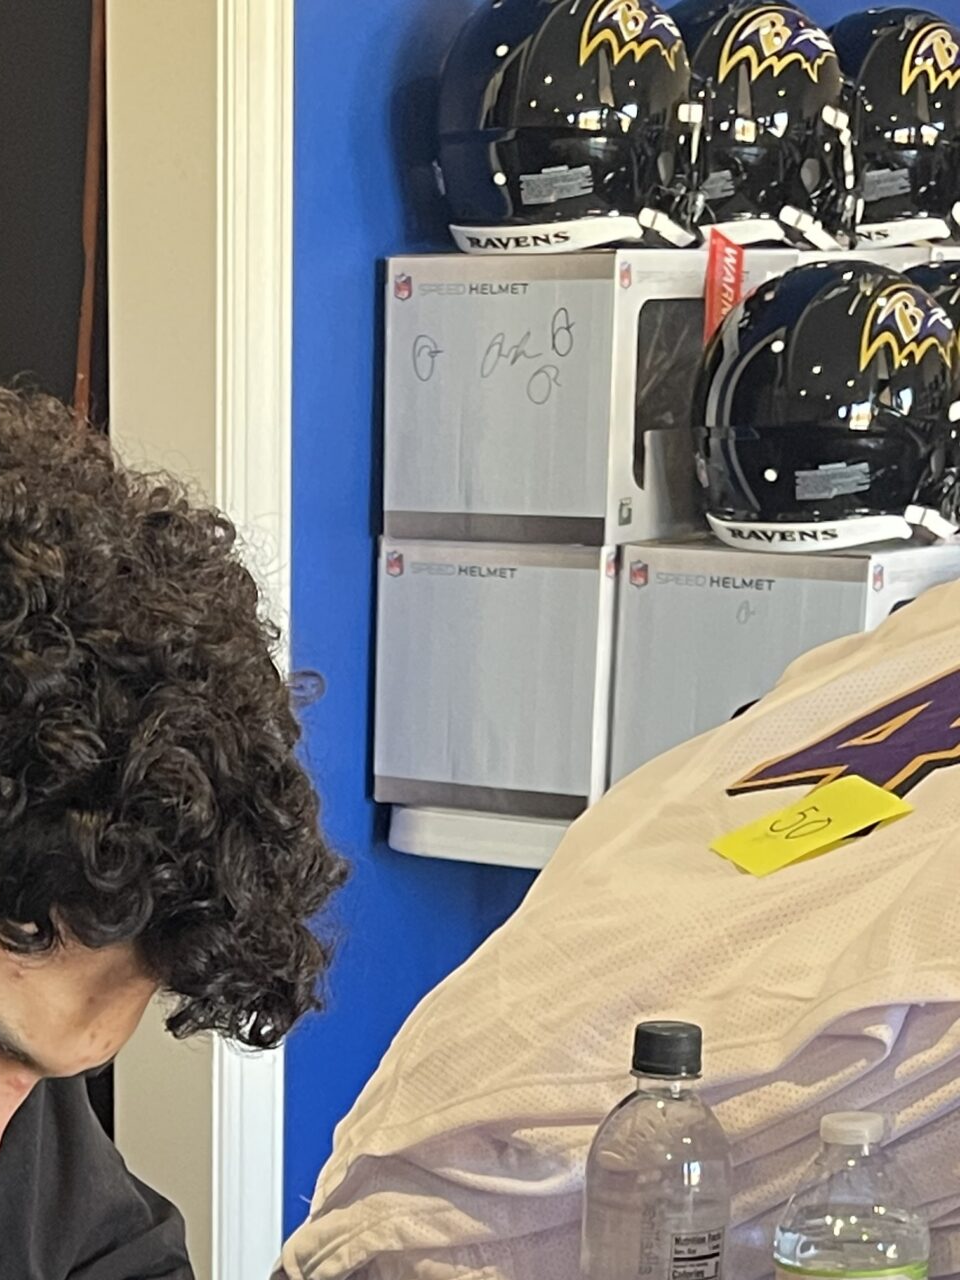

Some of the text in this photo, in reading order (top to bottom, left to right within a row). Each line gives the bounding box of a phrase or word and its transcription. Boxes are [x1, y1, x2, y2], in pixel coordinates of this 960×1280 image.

[466, 231, 571, 250] RAVENS
[469, 283, 529, 295] HELMET
[727, 528, 839, 542] RAVENS
[458, 565, 518, 579] HELMET
[655, 572, 776, 592] SPEED HELMET
